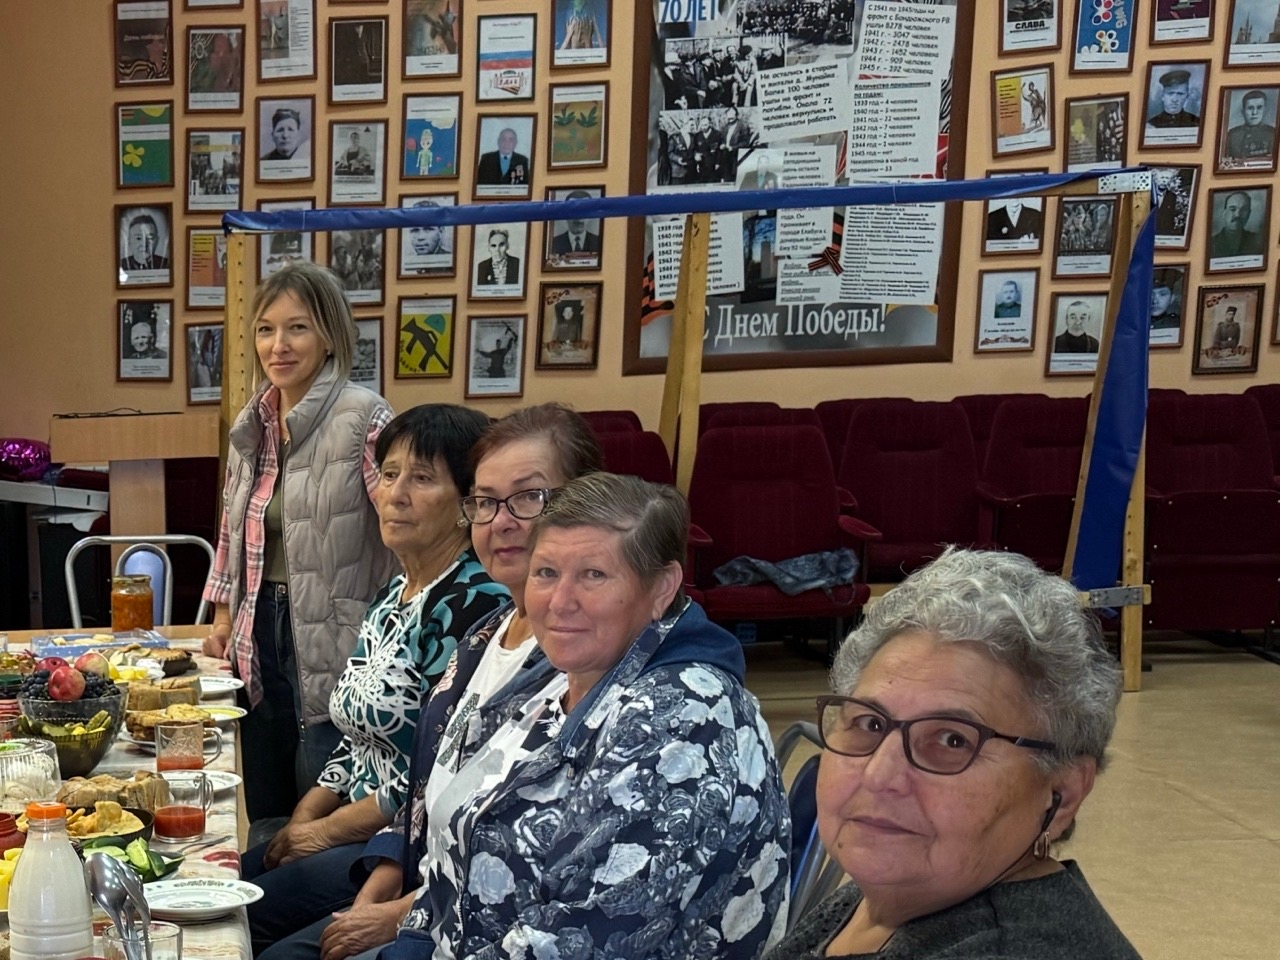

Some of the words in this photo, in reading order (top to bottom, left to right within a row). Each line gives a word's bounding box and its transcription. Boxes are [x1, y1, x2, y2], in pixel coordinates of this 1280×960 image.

[660, 0, 682, 23] 70
[1015, 20, 1045, 30] СЛАВА
[863, 38, 879, 46] 1942
[772, 70, 803, 79] остались
[811, 64, 838, 73] стороне
[768, 80, 794, 88] жители
[788, 85, 800, 93] 100
[802, 82, 830, 90] человек
[762, 98, 781, 106] ушли
[793, 92, 814, 103] фронт
[823, 97, 832, 105] 72
[792, 108, 827, 118] вернулись
[714, 304, 780, 348] Днем
[784, 302, 886, 341] Победы!
